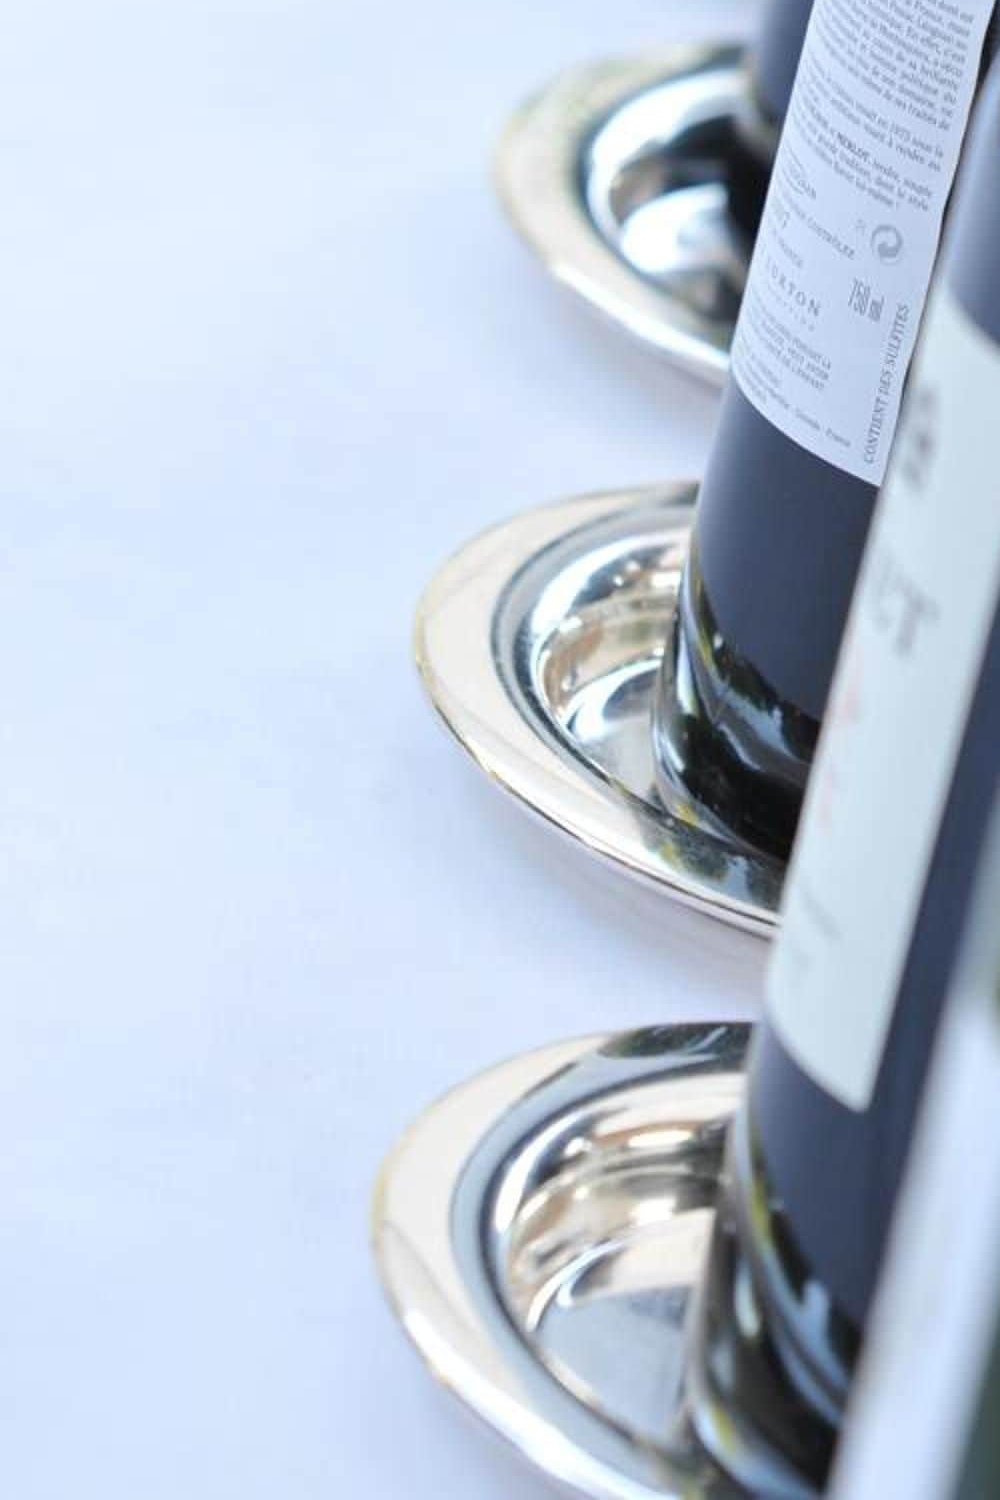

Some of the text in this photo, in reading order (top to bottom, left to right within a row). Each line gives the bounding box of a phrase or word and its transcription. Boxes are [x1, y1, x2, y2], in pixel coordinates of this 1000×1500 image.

[864, 303, 910, 465] CONTIENT DES SULFITES
